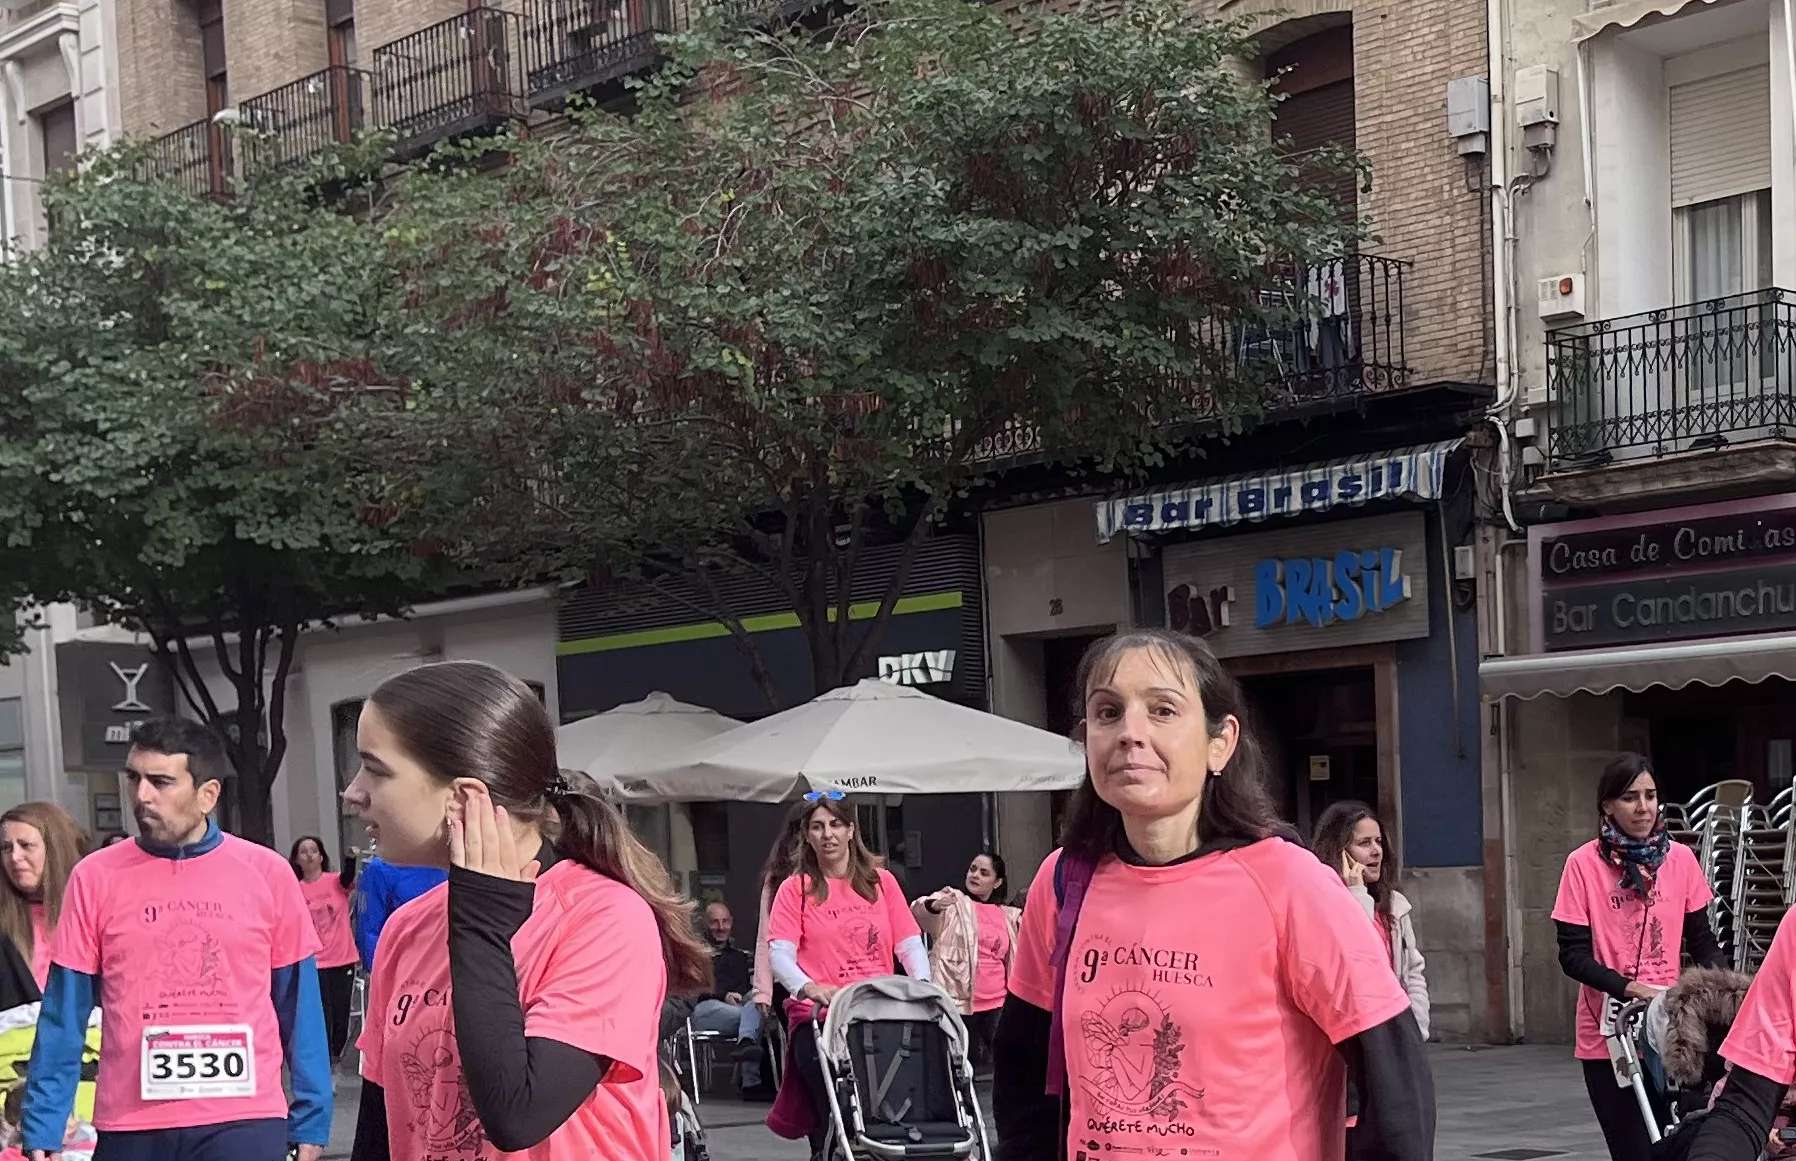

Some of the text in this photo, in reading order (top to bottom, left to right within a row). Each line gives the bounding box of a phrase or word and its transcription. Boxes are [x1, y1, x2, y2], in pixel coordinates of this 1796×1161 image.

[1124, 462, 1402, 526] Bar Brasil
[1550, 542, 1617, 573] Casa
[1631, 534, 1660, 562] de
[1552, 579, 1796, 634] Bar Candanchu
[878, 650, 956, 685] DKV
[1114, 942, 1199, 971] CÁNCER
[1153, 969, 1214, 988] HUESCA
[152, 1052, 244, 1079] 3530
[1146, 1123, 1195, 1136] MUCHO
